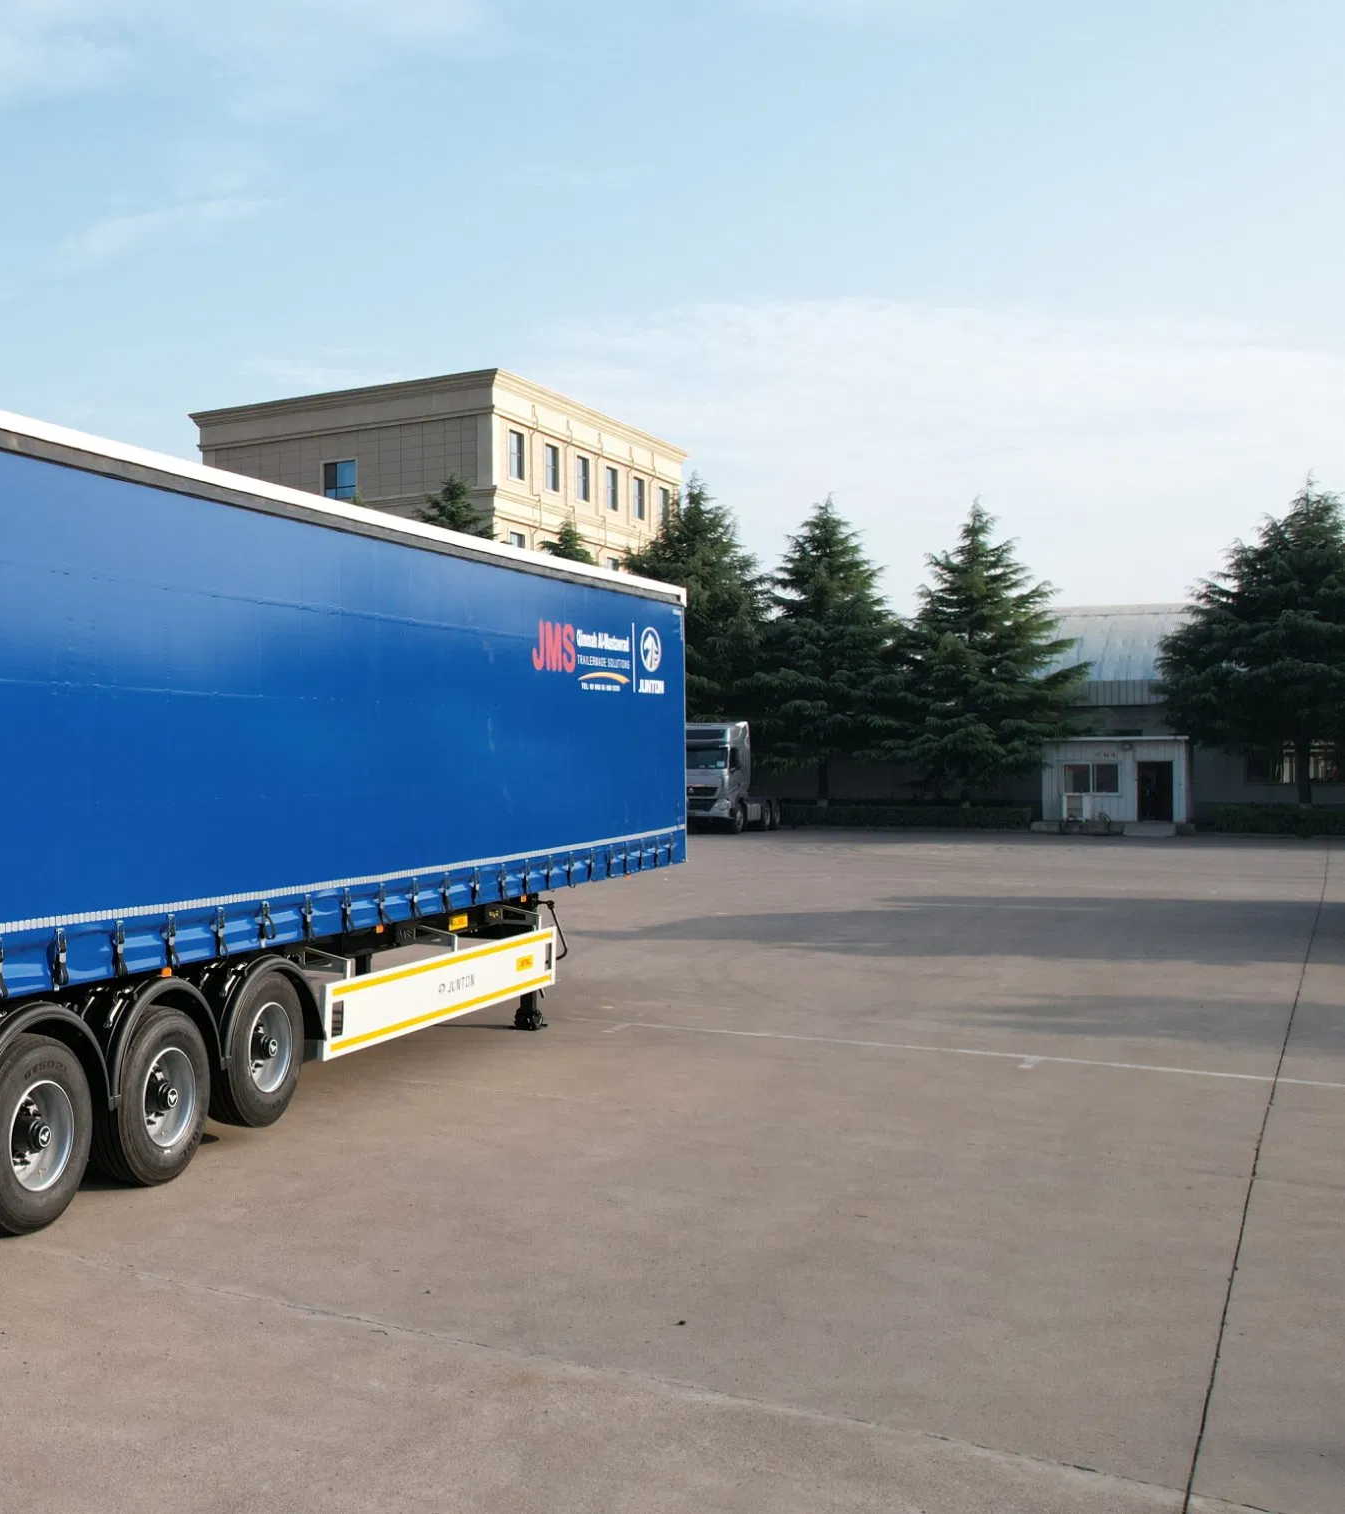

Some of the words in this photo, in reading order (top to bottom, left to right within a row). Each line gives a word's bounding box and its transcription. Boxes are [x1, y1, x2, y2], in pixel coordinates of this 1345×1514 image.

[532, 618, 576, 673] JMS
[638, 679, 665, 694] JUNTON
[447, 973, 476, 993] JUNTON
